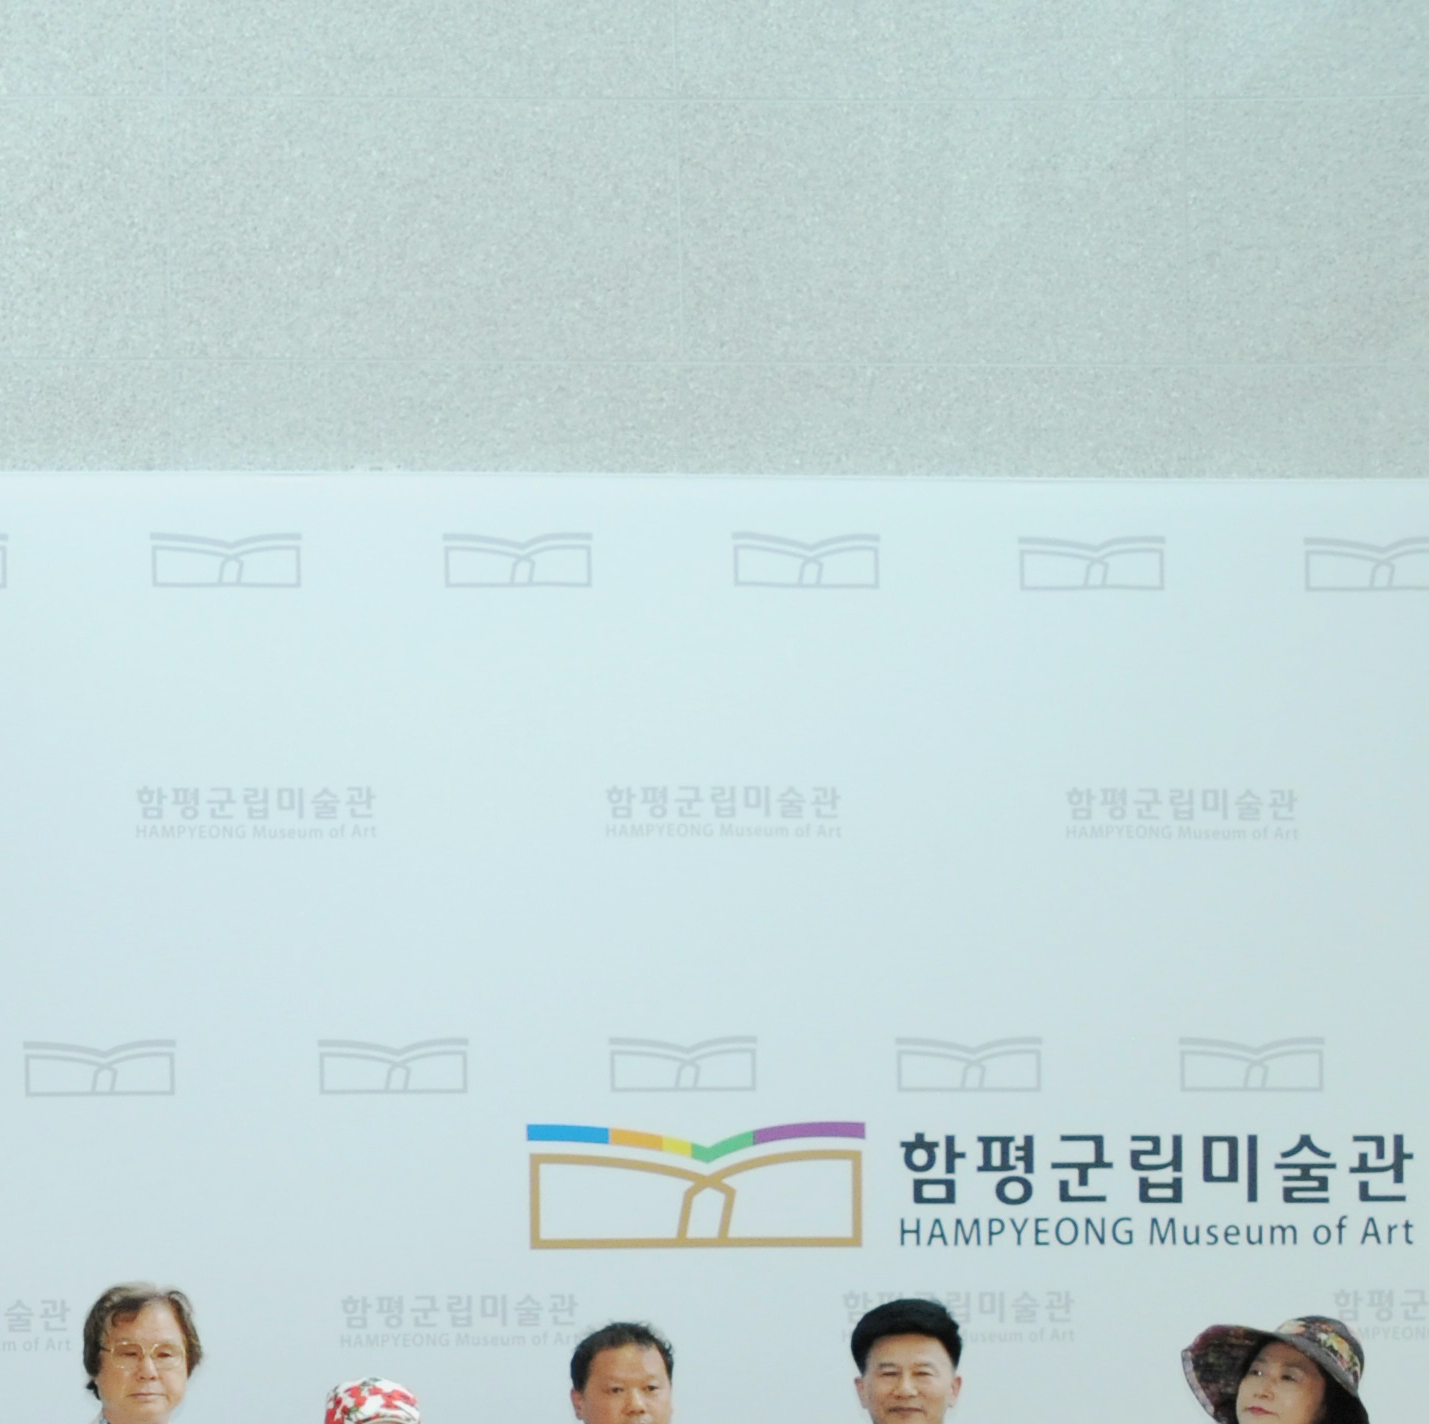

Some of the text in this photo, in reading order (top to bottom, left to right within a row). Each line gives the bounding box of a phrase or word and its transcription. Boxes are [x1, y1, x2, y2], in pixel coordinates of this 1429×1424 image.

[136, 785, 377, 820] 함평군립미술관
[605, 785, 842, 819] 함평군립미술관
[1065, 787, 1298, 821] 함평군립미술관
[135, 823, 377, 839] HAMPYEONG Museum of Art
[605, 823, 842, 838] HAMPYEONG Museum of Art
[1065, 825, 1299, 840] HAMPYEONG Museum of Art
[900, 1133, 1414, 1205] 함평군립미술관
[900, 1215, 1414, 1246] HAMPYEONG Museum of Art
[341, 1295, 579, 1329] 함평군립미술관
[23, 1336, 40, 1351] of
[44, 1337, 71, 1351] Art
[340, 1333, 449, 1348] HAMPYEONG
[456, 1332, 526, 1347] Museum
[532, 1331, 549, 1346] of
[1028, 1327, 1045, 1343] of
[1049, 1328, 1075, 1342] Art
